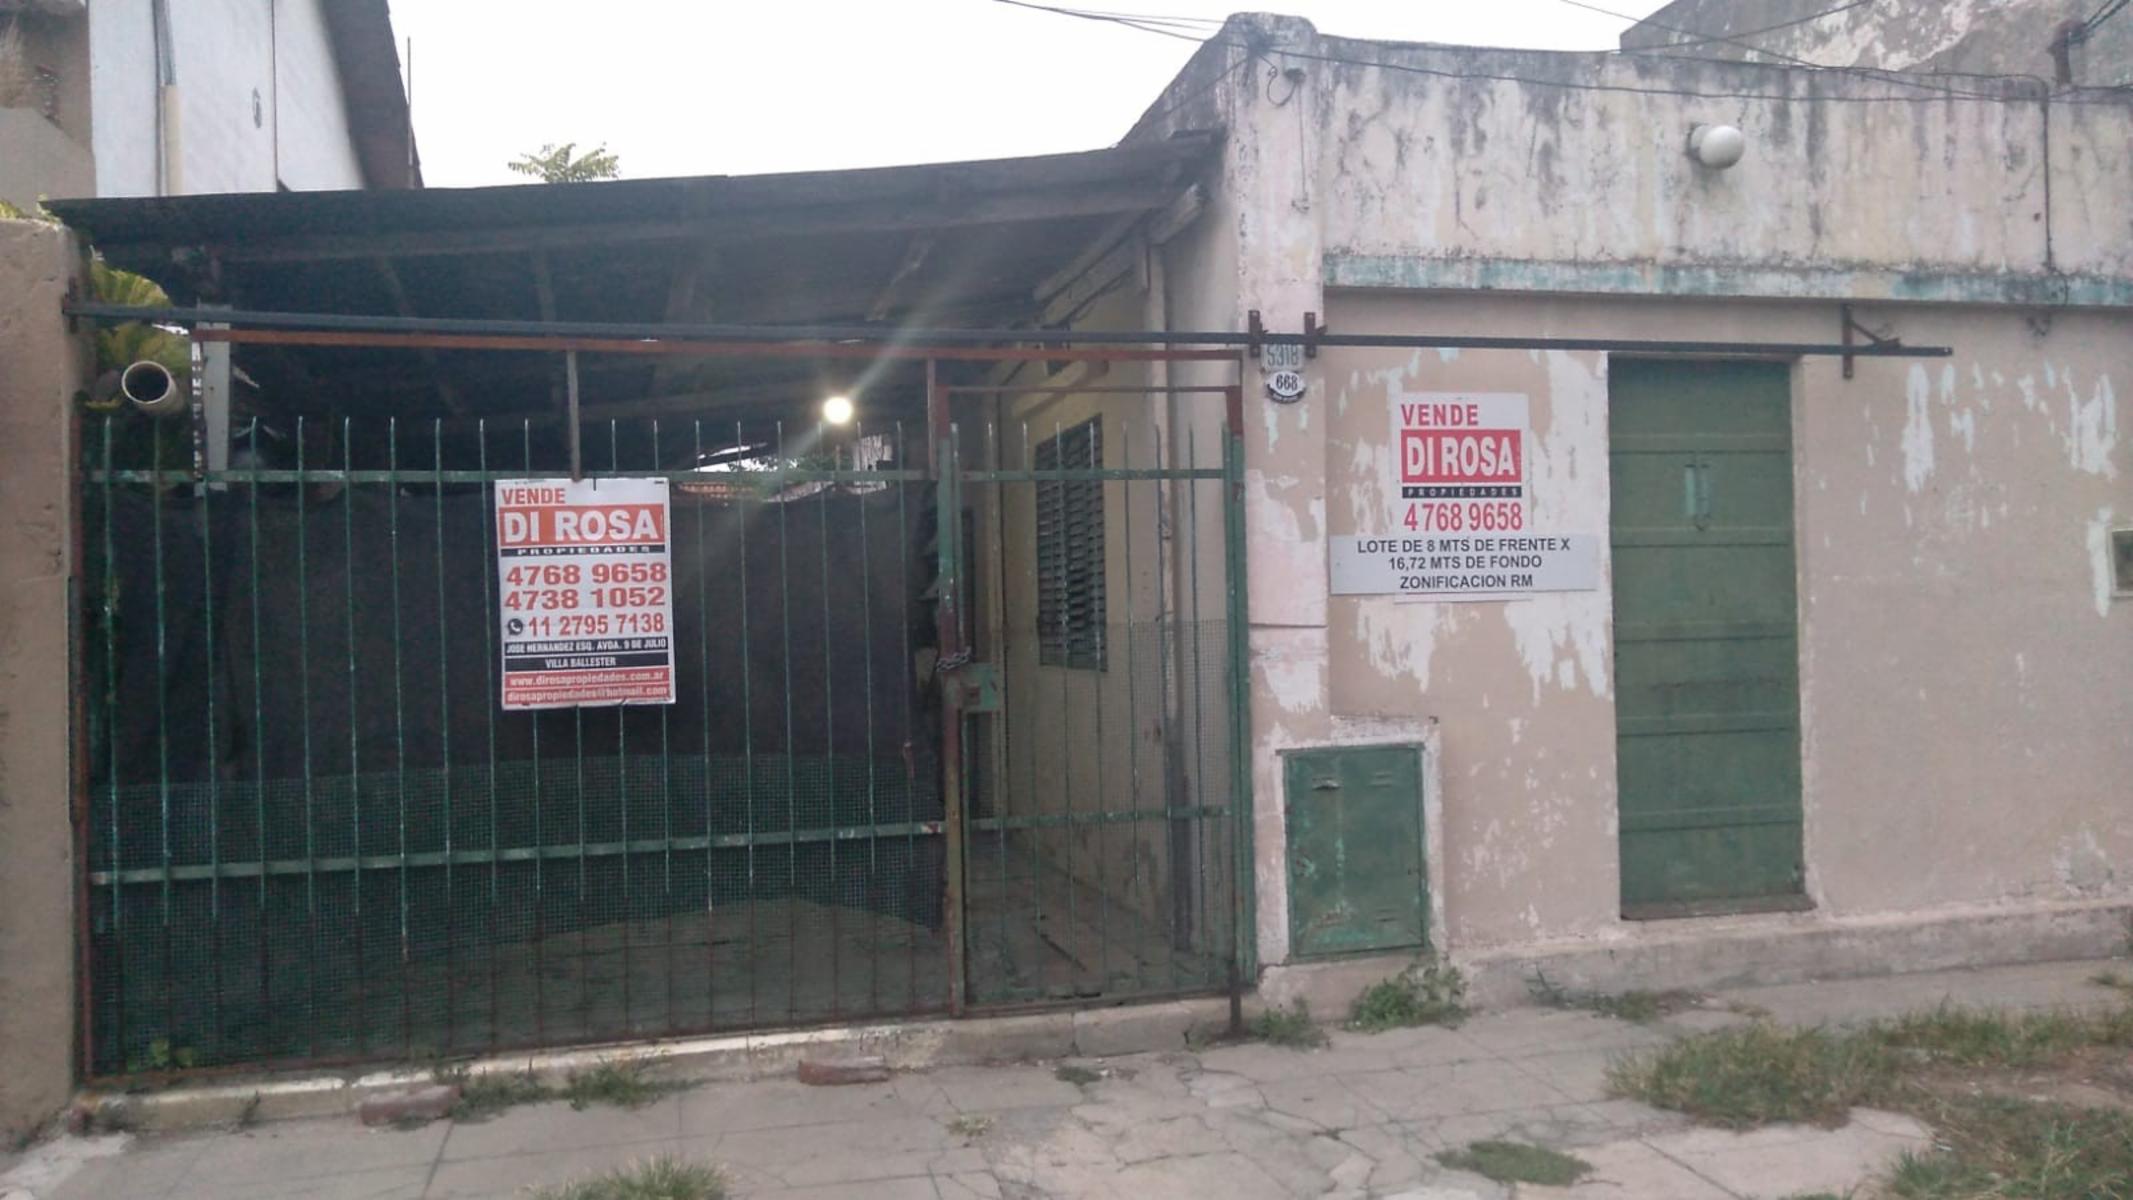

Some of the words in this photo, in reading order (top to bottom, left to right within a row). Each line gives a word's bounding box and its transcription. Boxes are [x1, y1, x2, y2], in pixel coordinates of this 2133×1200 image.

[1276, 374, 1298, 391] 668
[1401, 404, 1479, 426] VENDE
[1407, 437, 1435, 476] DI
[1441, 436, 1515, 476] ROSA
[502, 488, 566, 504] VENDE
[1407, 487, 1519, 497] PROPIEDADES
[1404, 504, 1462, 531] 4768
[1468, 502, 1523, 531] 9658
[504, 511, 540, 543] DI
[554, 509, 659, 541] ROSA
[517, 546, 650, 556] PROPIEDADES
[1357, 540, 1397, 553] LOTE
[1402, 539, 1422, 552] DE
[1427, 539, 1436, 552] 8
[1440, 538, 1470, 552] MTS
[1475, 538, 1495, 551] DE
[1499, 538, 1556, 551] FRENTE
[1561, 538, 1571, 551] X
[1388, 557, 1426, 571] 16,72
[1430, 556, 1460, 570] MTS
[1466, 556, 1486, 569] DE
[1490, 555, 1542, 569] FONDO
[506, 564, 580, 586] 4768
[592, 562, 667, 584] 9658
[1400, 575, 1506, 589] ZONIFICACION
[1511, 574, 1533, 587] RM
[504, 589, 579, 610] 4738
[590, 587, 665, 608] 1052
[529, 617, 550, 636] 11
[559, 615, 608, 636] 2795
[615, 612, 665, 634] 7138
[506, 643, 525, 654] JOSE
[624, 640, 630, 649] 9
[632, 640, 642, 649] DE
[644, 638, 666, 649] JULIO
[545, 658, 567, 669] VILLA
[570, 657, 616, 668] BALLESTER
